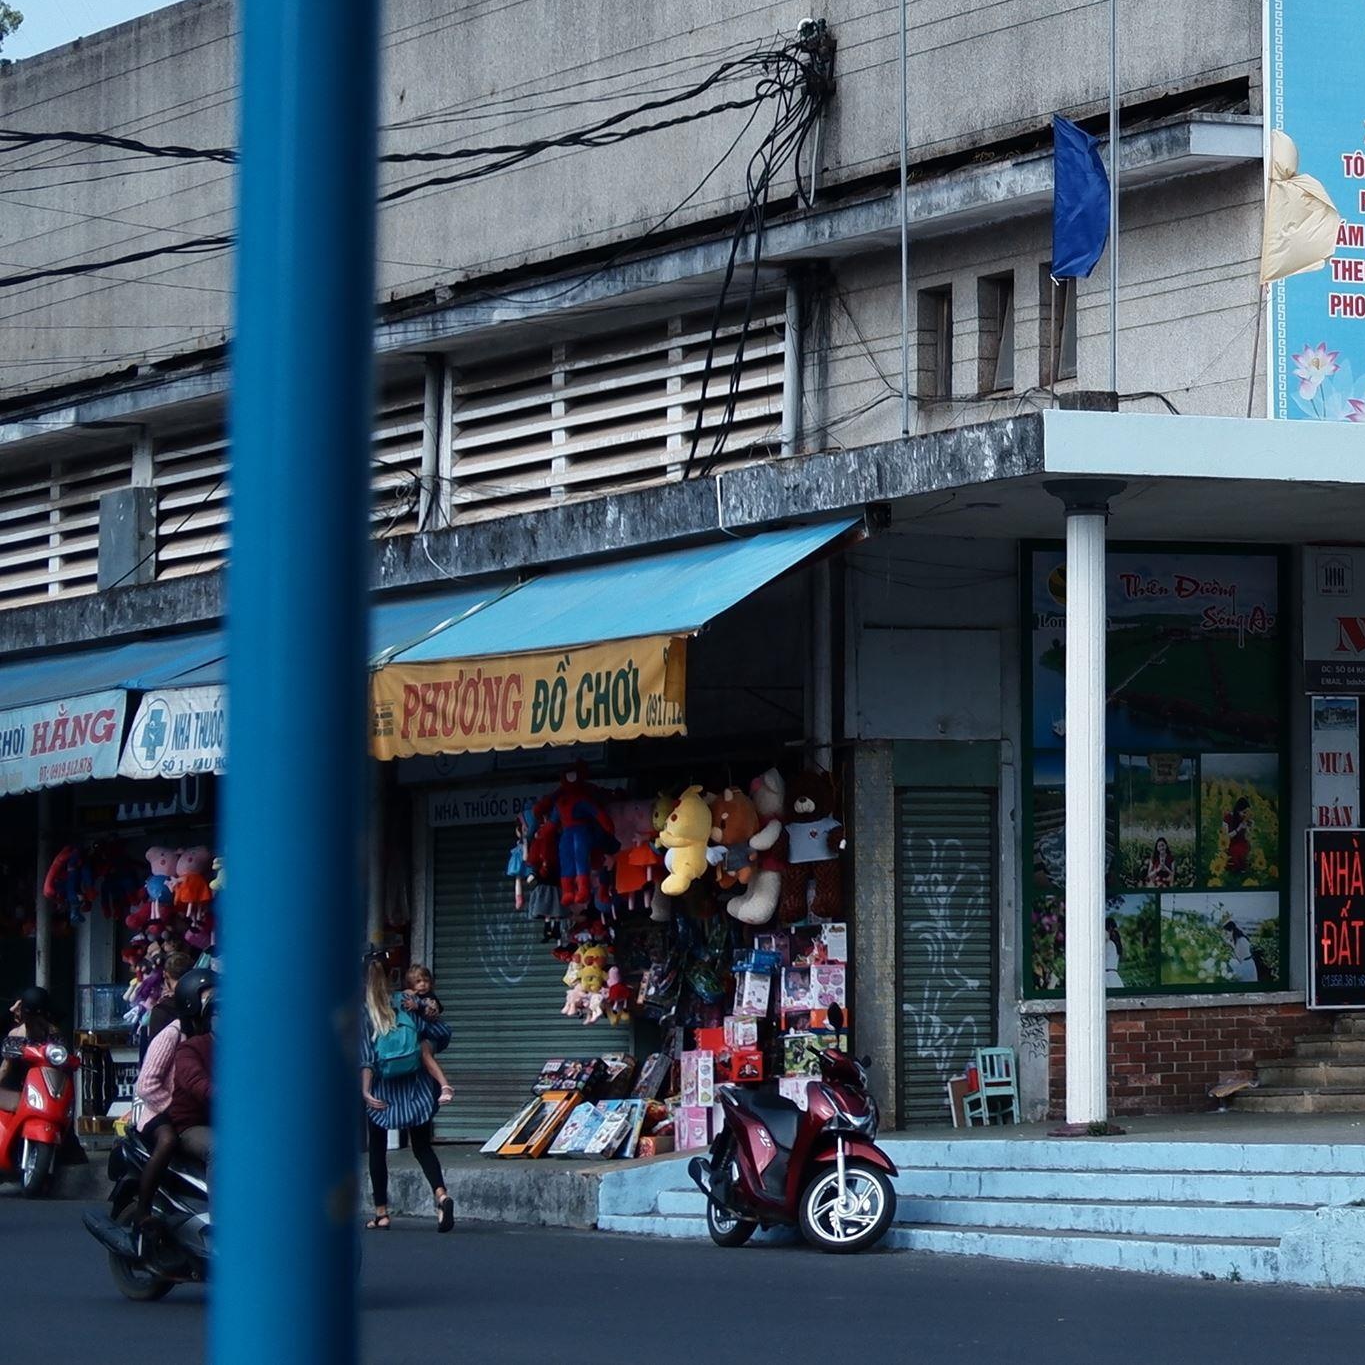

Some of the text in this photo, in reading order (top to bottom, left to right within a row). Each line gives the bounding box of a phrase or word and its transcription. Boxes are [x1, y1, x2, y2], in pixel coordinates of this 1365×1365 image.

[1119, 573, 1169, 599] Thiên
[401, 667, 523, 740] PHƯƠNG
[530, 654, 572, 734] ĐỒ
[576, 659, 641, 730] CHƠI
[1317, 752, 1354, 773] MUA
[1319, 797, 1353, 827] BÁN
[1319, 837, 1364, 897] NHÀ
[1321, 899, 1364, 966] ĐẤT
